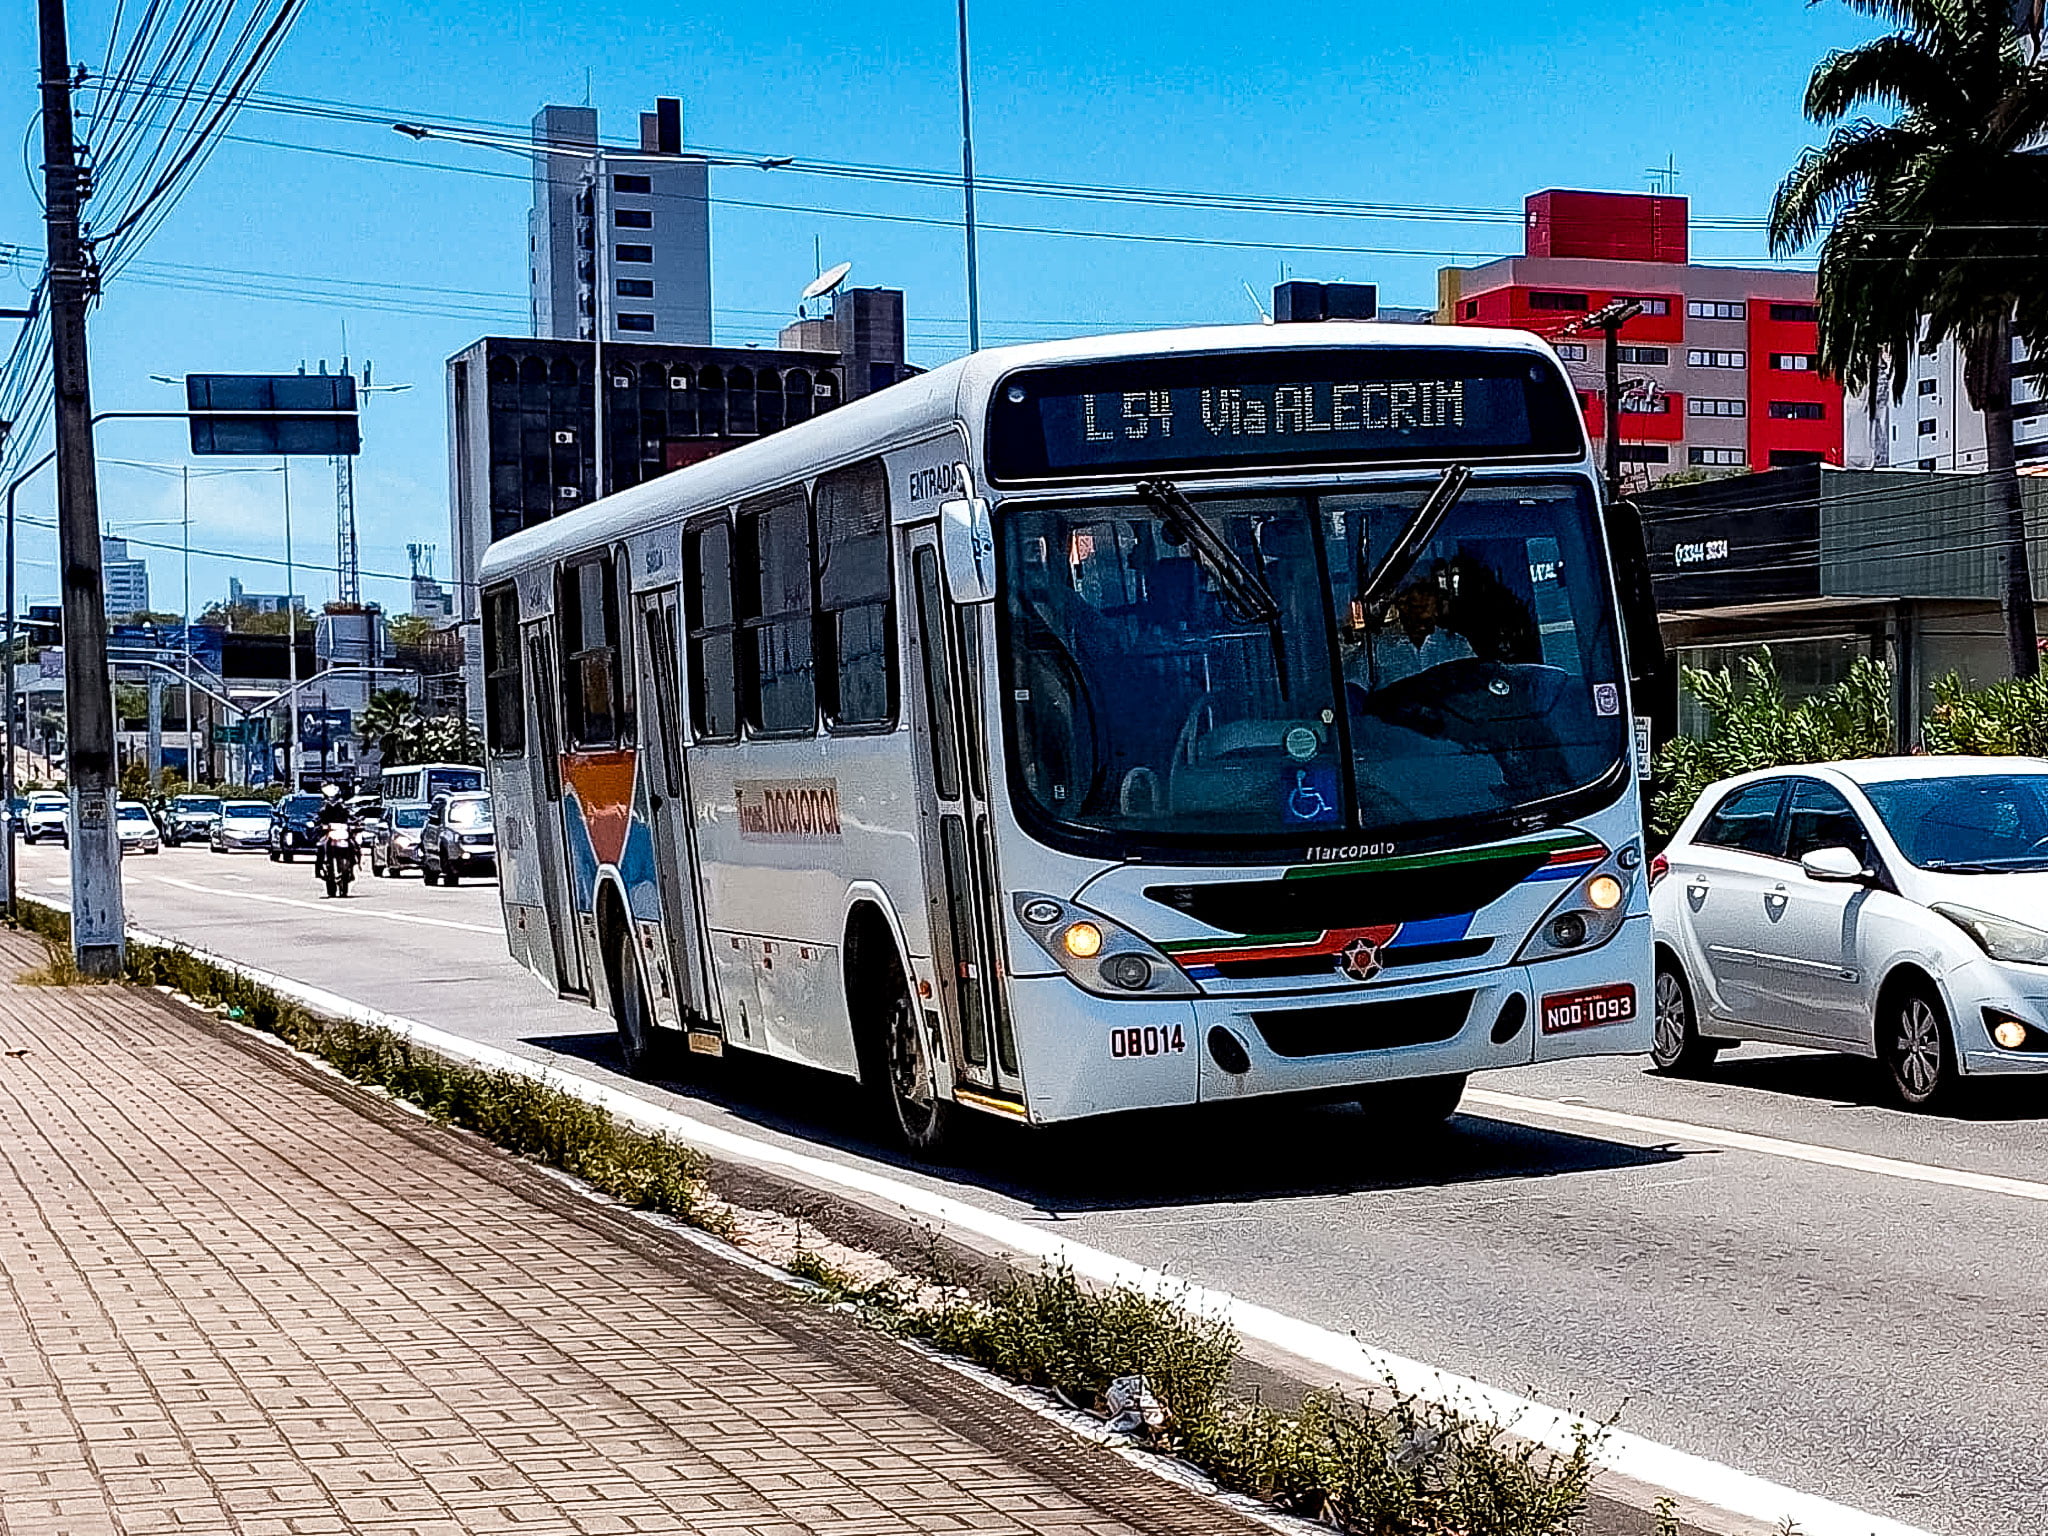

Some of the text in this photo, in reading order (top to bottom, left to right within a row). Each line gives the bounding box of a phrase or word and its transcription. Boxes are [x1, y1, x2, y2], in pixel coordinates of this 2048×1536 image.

[1083, 380, 1464, 441] L 54 Via ALECRIM
